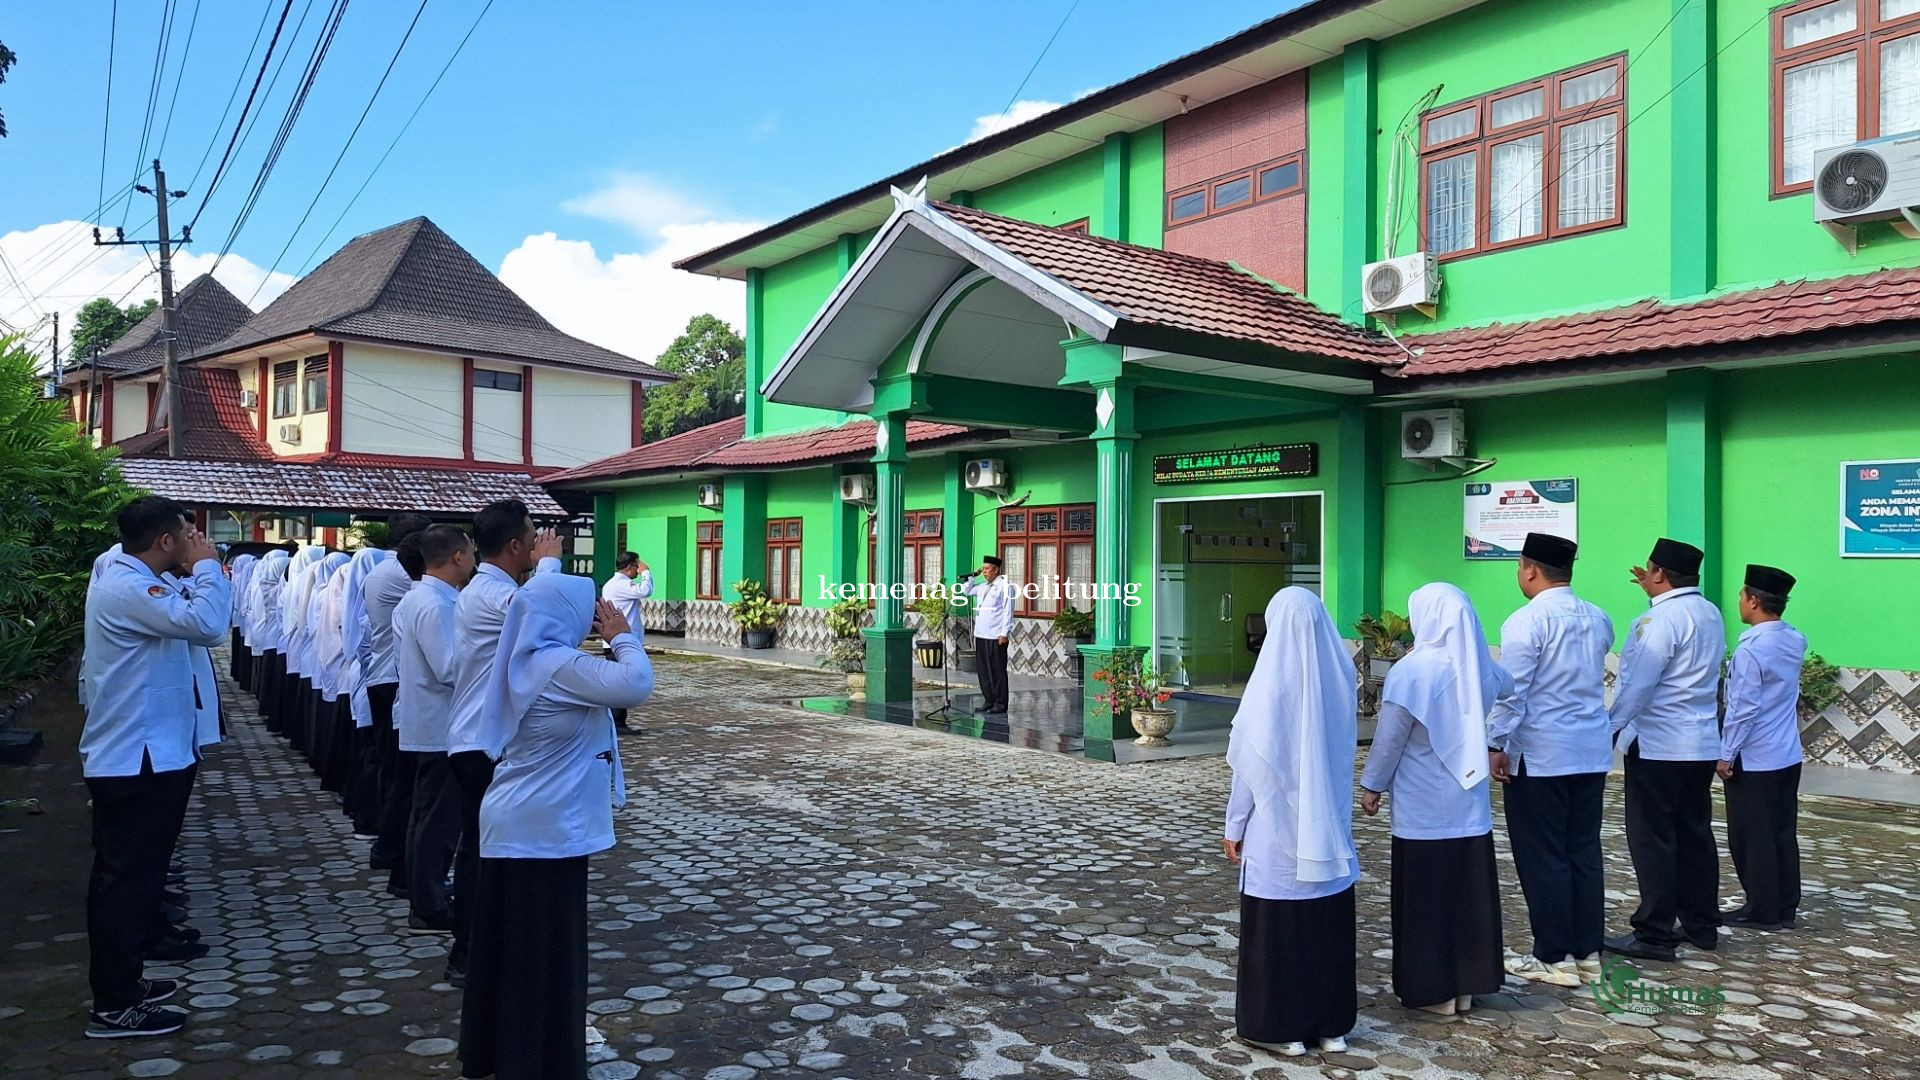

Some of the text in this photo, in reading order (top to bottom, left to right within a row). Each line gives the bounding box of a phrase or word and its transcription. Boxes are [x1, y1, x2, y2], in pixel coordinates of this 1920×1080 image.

[1176, 451, 1280, 469] SELAMAT DATANG
[1258, 465, 1280, 473] AGAMA
[1860, 469, 1879, 477] NO
[1860, 498, 1887, 506] ANDA
[1860, 506, 1901, 516] ZONA
